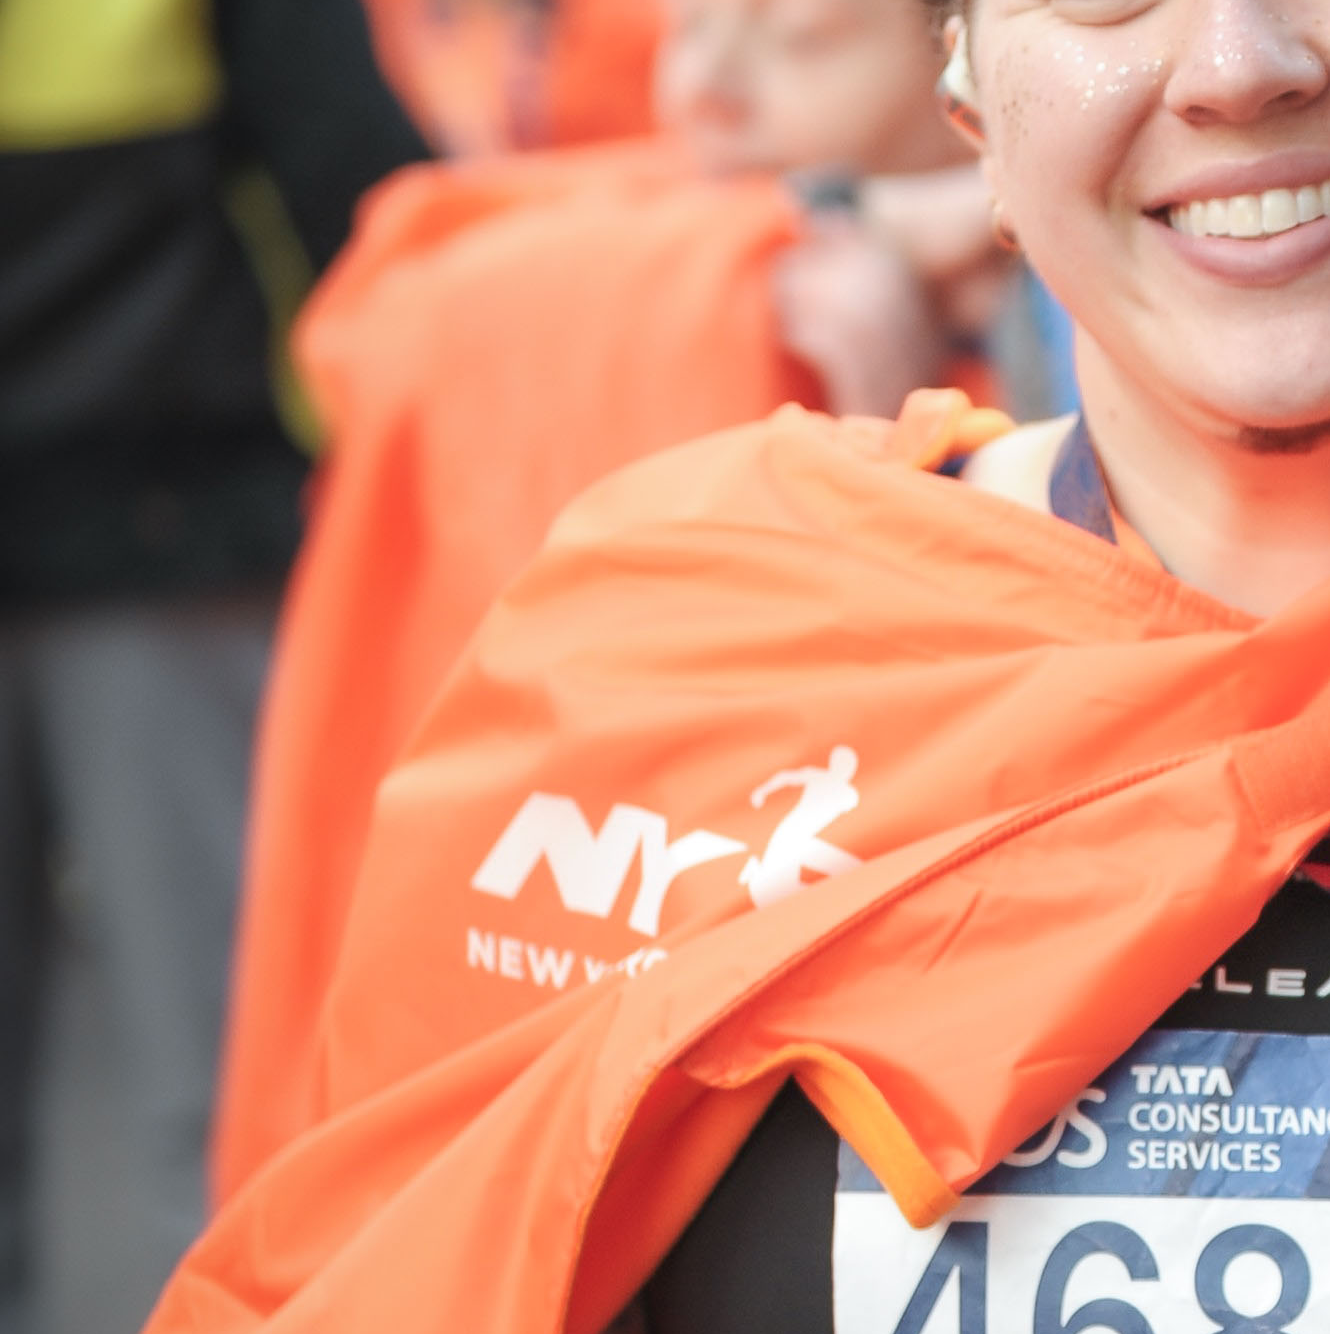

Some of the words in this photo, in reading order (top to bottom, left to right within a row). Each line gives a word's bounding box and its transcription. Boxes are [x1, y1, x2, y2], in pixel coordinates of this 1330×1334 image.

[466, 926, 576, 989] NEW
[1131, 1065, 1234, 1097] TATA
[1127, 1140, 1281, 1173] SERVICES
